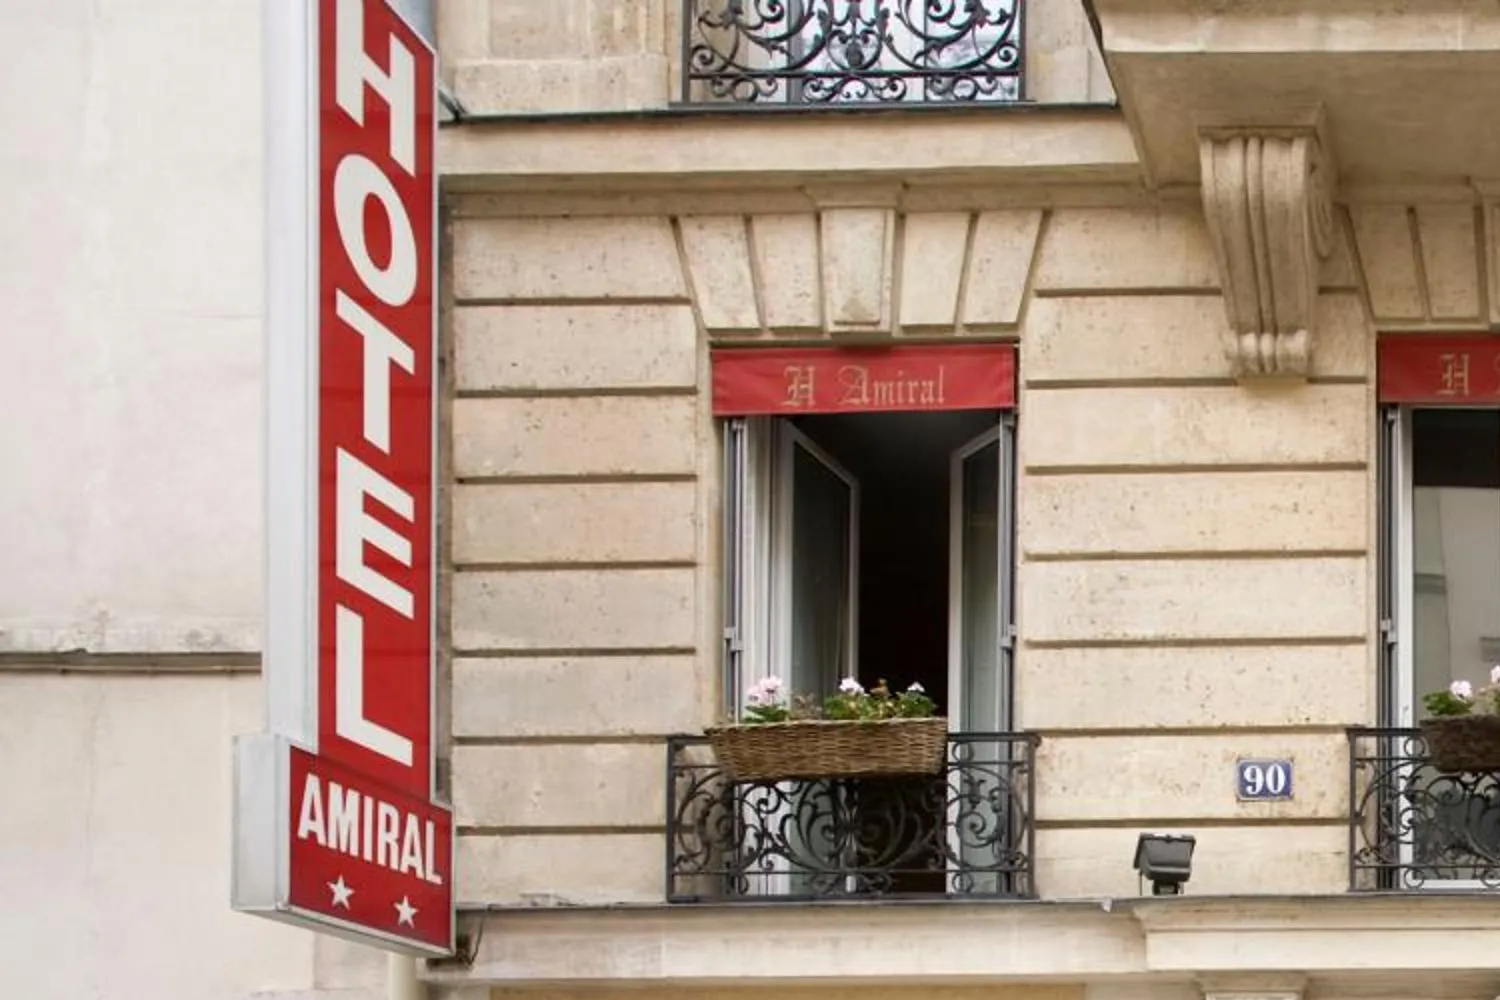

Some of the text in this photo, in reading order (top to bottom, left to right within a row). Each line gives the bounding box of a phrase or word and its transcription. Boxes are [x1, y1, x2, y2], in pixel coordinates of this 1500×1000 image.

[334, 0, 418, 767] HOTEL
[837, 363, 945, 406] Amiral
[1243, 763, 1286, 795] 90
[298, 773, 443, 885] AMIRAL
